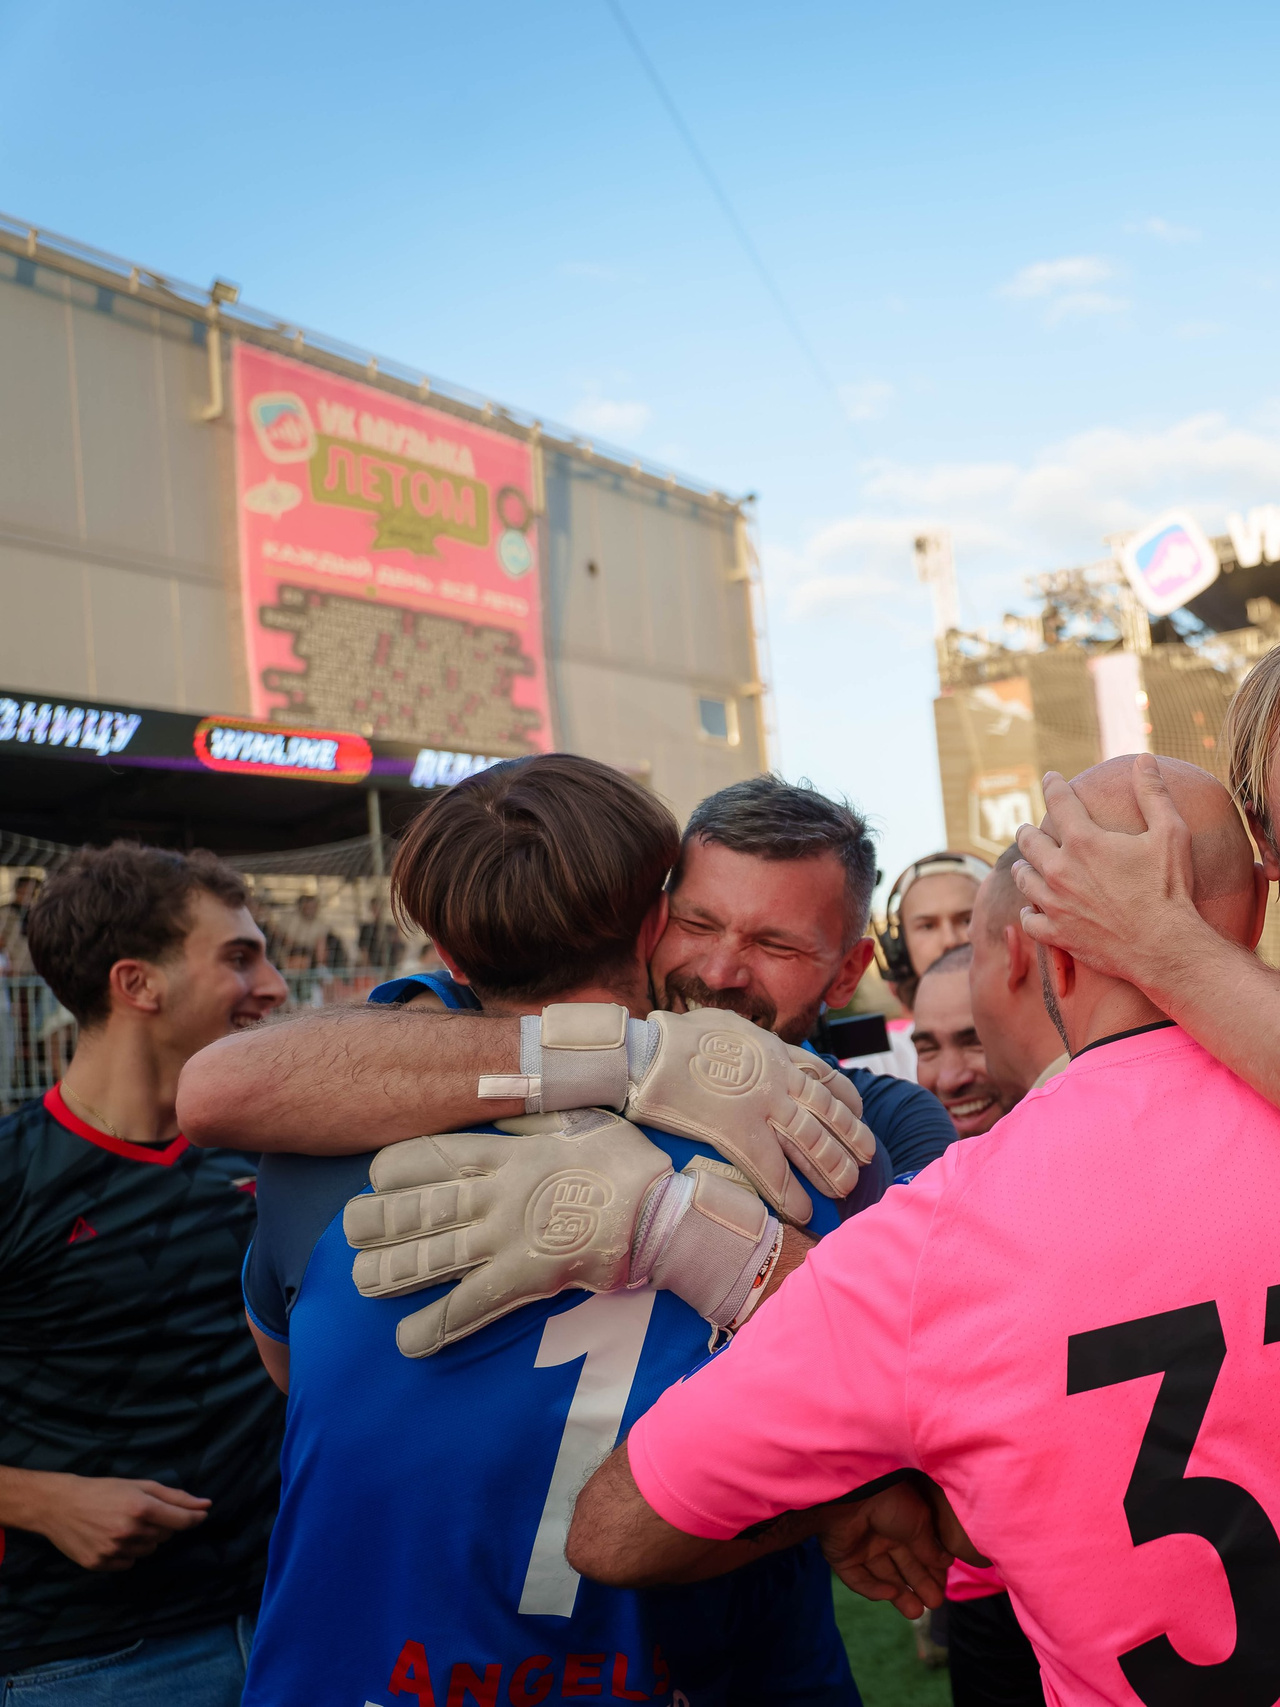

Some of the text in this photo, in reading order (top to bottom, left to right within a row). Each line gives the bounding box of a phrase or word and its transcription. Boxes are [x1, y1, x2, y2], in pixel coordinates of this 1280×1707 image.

[317, 398, 357, 441] VK
[324, 444, 477, 529] ЛЕТОМ
[210, 726, 339, 771] WINLINE
[517, 1290, 656, 1618] 1
